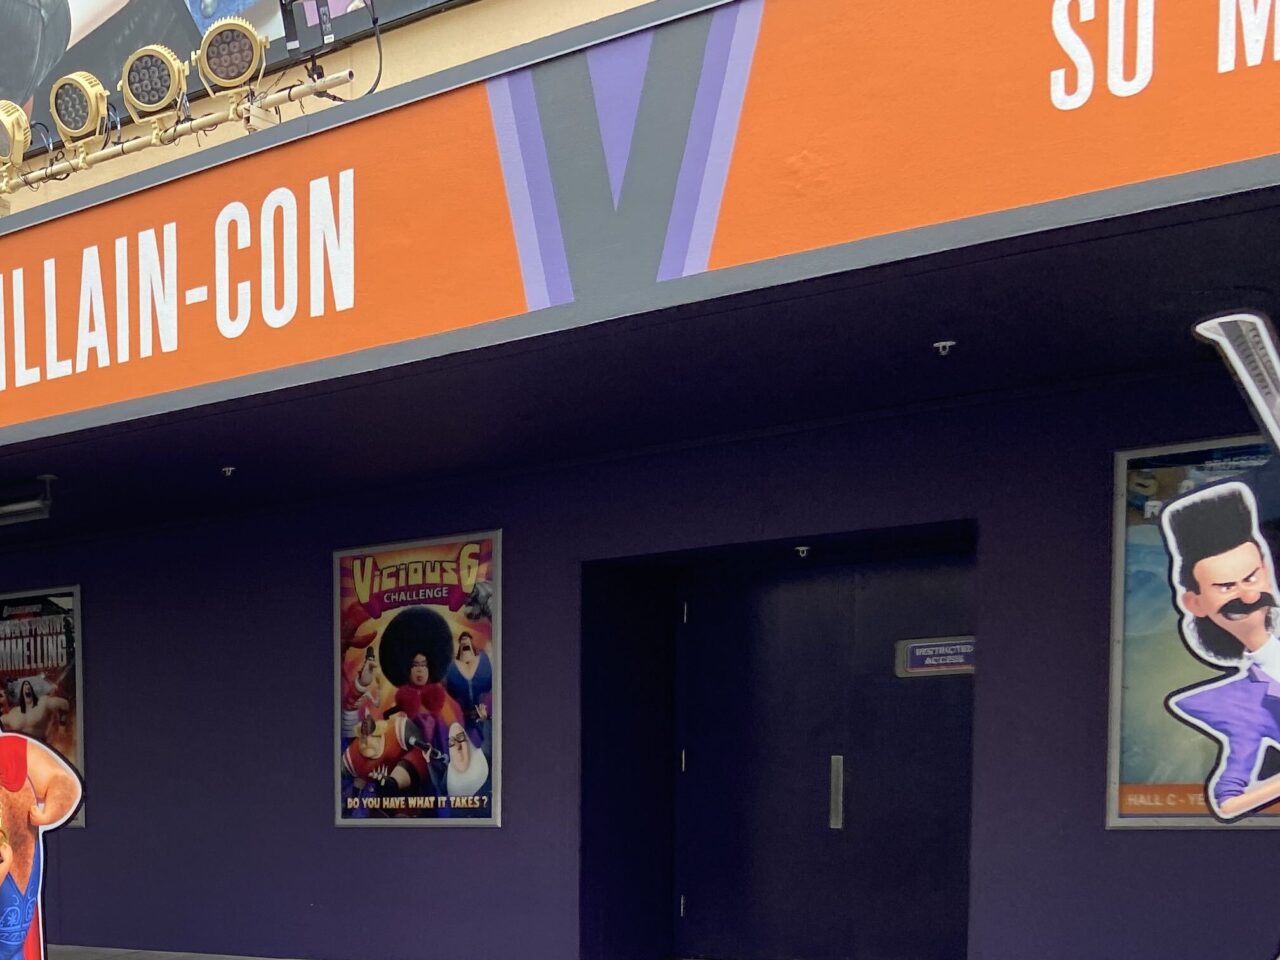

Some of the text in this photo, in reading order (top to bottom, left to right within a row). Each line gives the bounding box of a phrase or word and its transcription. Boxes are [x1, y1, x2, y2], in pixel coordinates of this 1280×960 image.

[383, 587, 449, 604] CHALLENGE
[915, 645, 974, 656] RESTRICTED
[924, 655, 965, 665] ACCESS
[347, 797, 360, 809] DO
[362, 797, 381, 809] YOU
[382, 797, 406, 809] HAVE
[408, 796, 435, 809] WHAT
[437, 796, 448, 808] IT
[450, 795, 480, 808] TAKES
[1128, 793, 1164, 806] HALL
